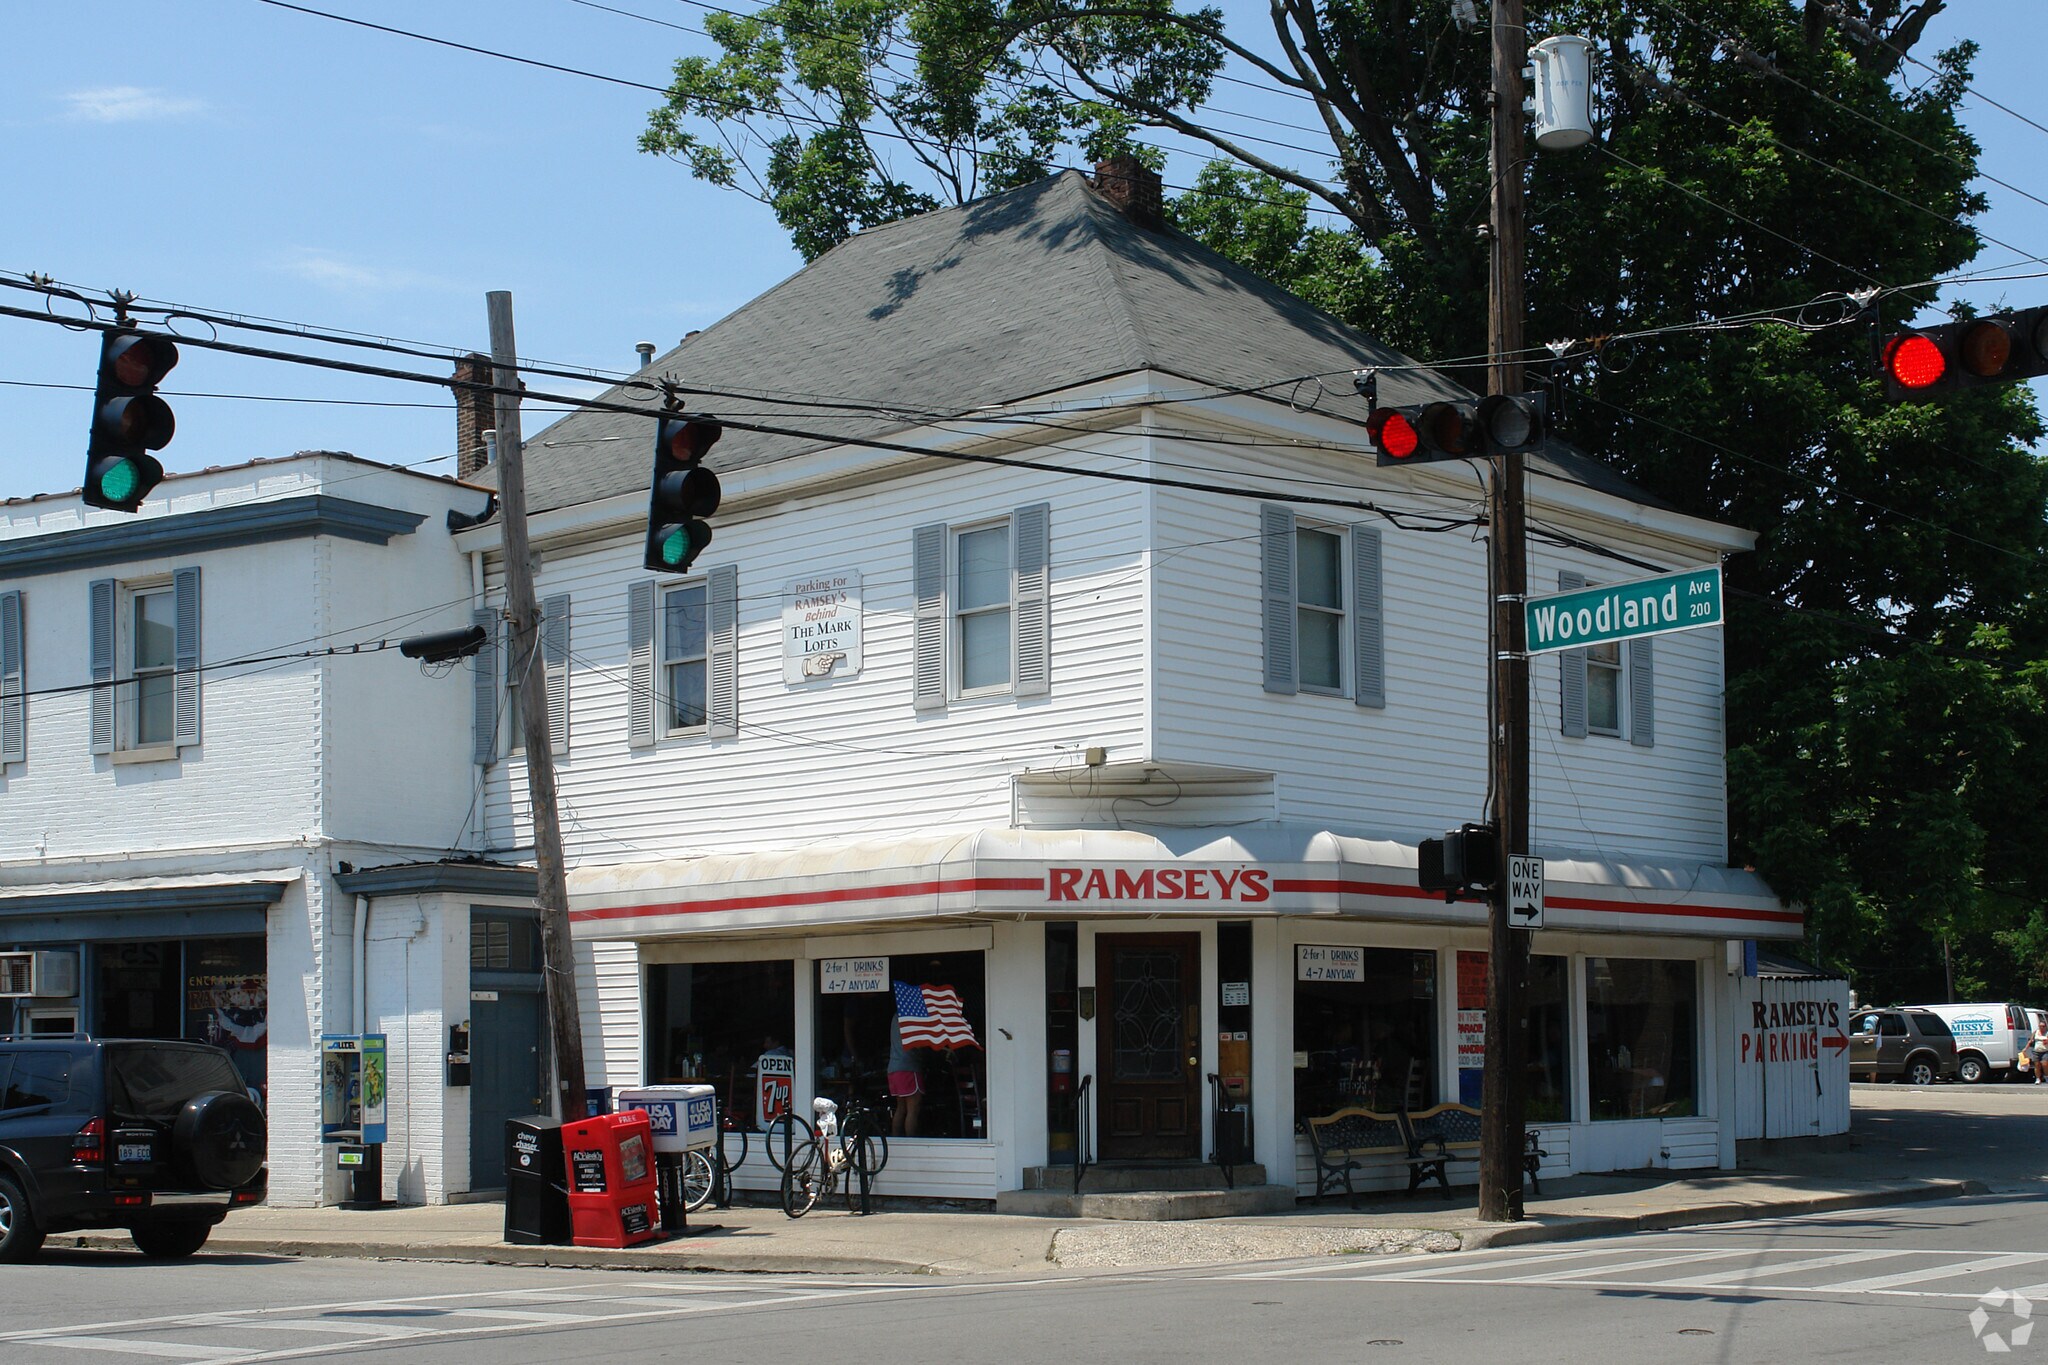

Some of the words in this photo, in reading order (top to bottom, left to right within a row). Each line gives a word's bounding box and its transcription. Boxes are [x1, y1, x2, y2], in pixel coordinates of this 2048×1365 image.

[795, 579, 830, 594] Parking
[795, 590, 847, 611] RAMSEY'S
[804, 606, 838, 622] Behind
[1534, 584, 1678, 643] Woodland
[1688, 581, 1711, 596] Ave
[1690, 601, 1711, 618] 200
[817, 620, 852, 636] MARK
[804, 638, 838, 653] LOFTS
[1513, 861, 1540, 880] ONE
[1048, 864, 1270, 902] RAMSEY'S
[1512, 881, 1540, 899] WAY
[1330, 950, 1359, 961] DRINKS
[853, 960, 884, 972] DRINKS
[1305, 967, 1323, 979] 4-7
[1325, 968, 1356, 979] ANYDAY
[188, 974, 247, 986] ENTRANCE
[828, 980, 846, 991] 4-7
[848, 980, 880, 991] ANYDAY
[1466, 1012, 1480, 1022] THE
[1752, 998, 1840, 1029] RAMSEY'S
[1742, 1031, 1818, 1063] PARKING
[761, 1058, 791, 1071] OPEN
[644, 1104, 672, 1117] USA
[696, 1100, 712, 1115] USA
[618, 1114, 637, 1124] FREE
[650, 1117, 674, 1130] DAY
[689, 1111, 713, 1126] TODAY
[517, 1131, 537, 1144] chevy
[515, 1140, 538, 1151] chaser
